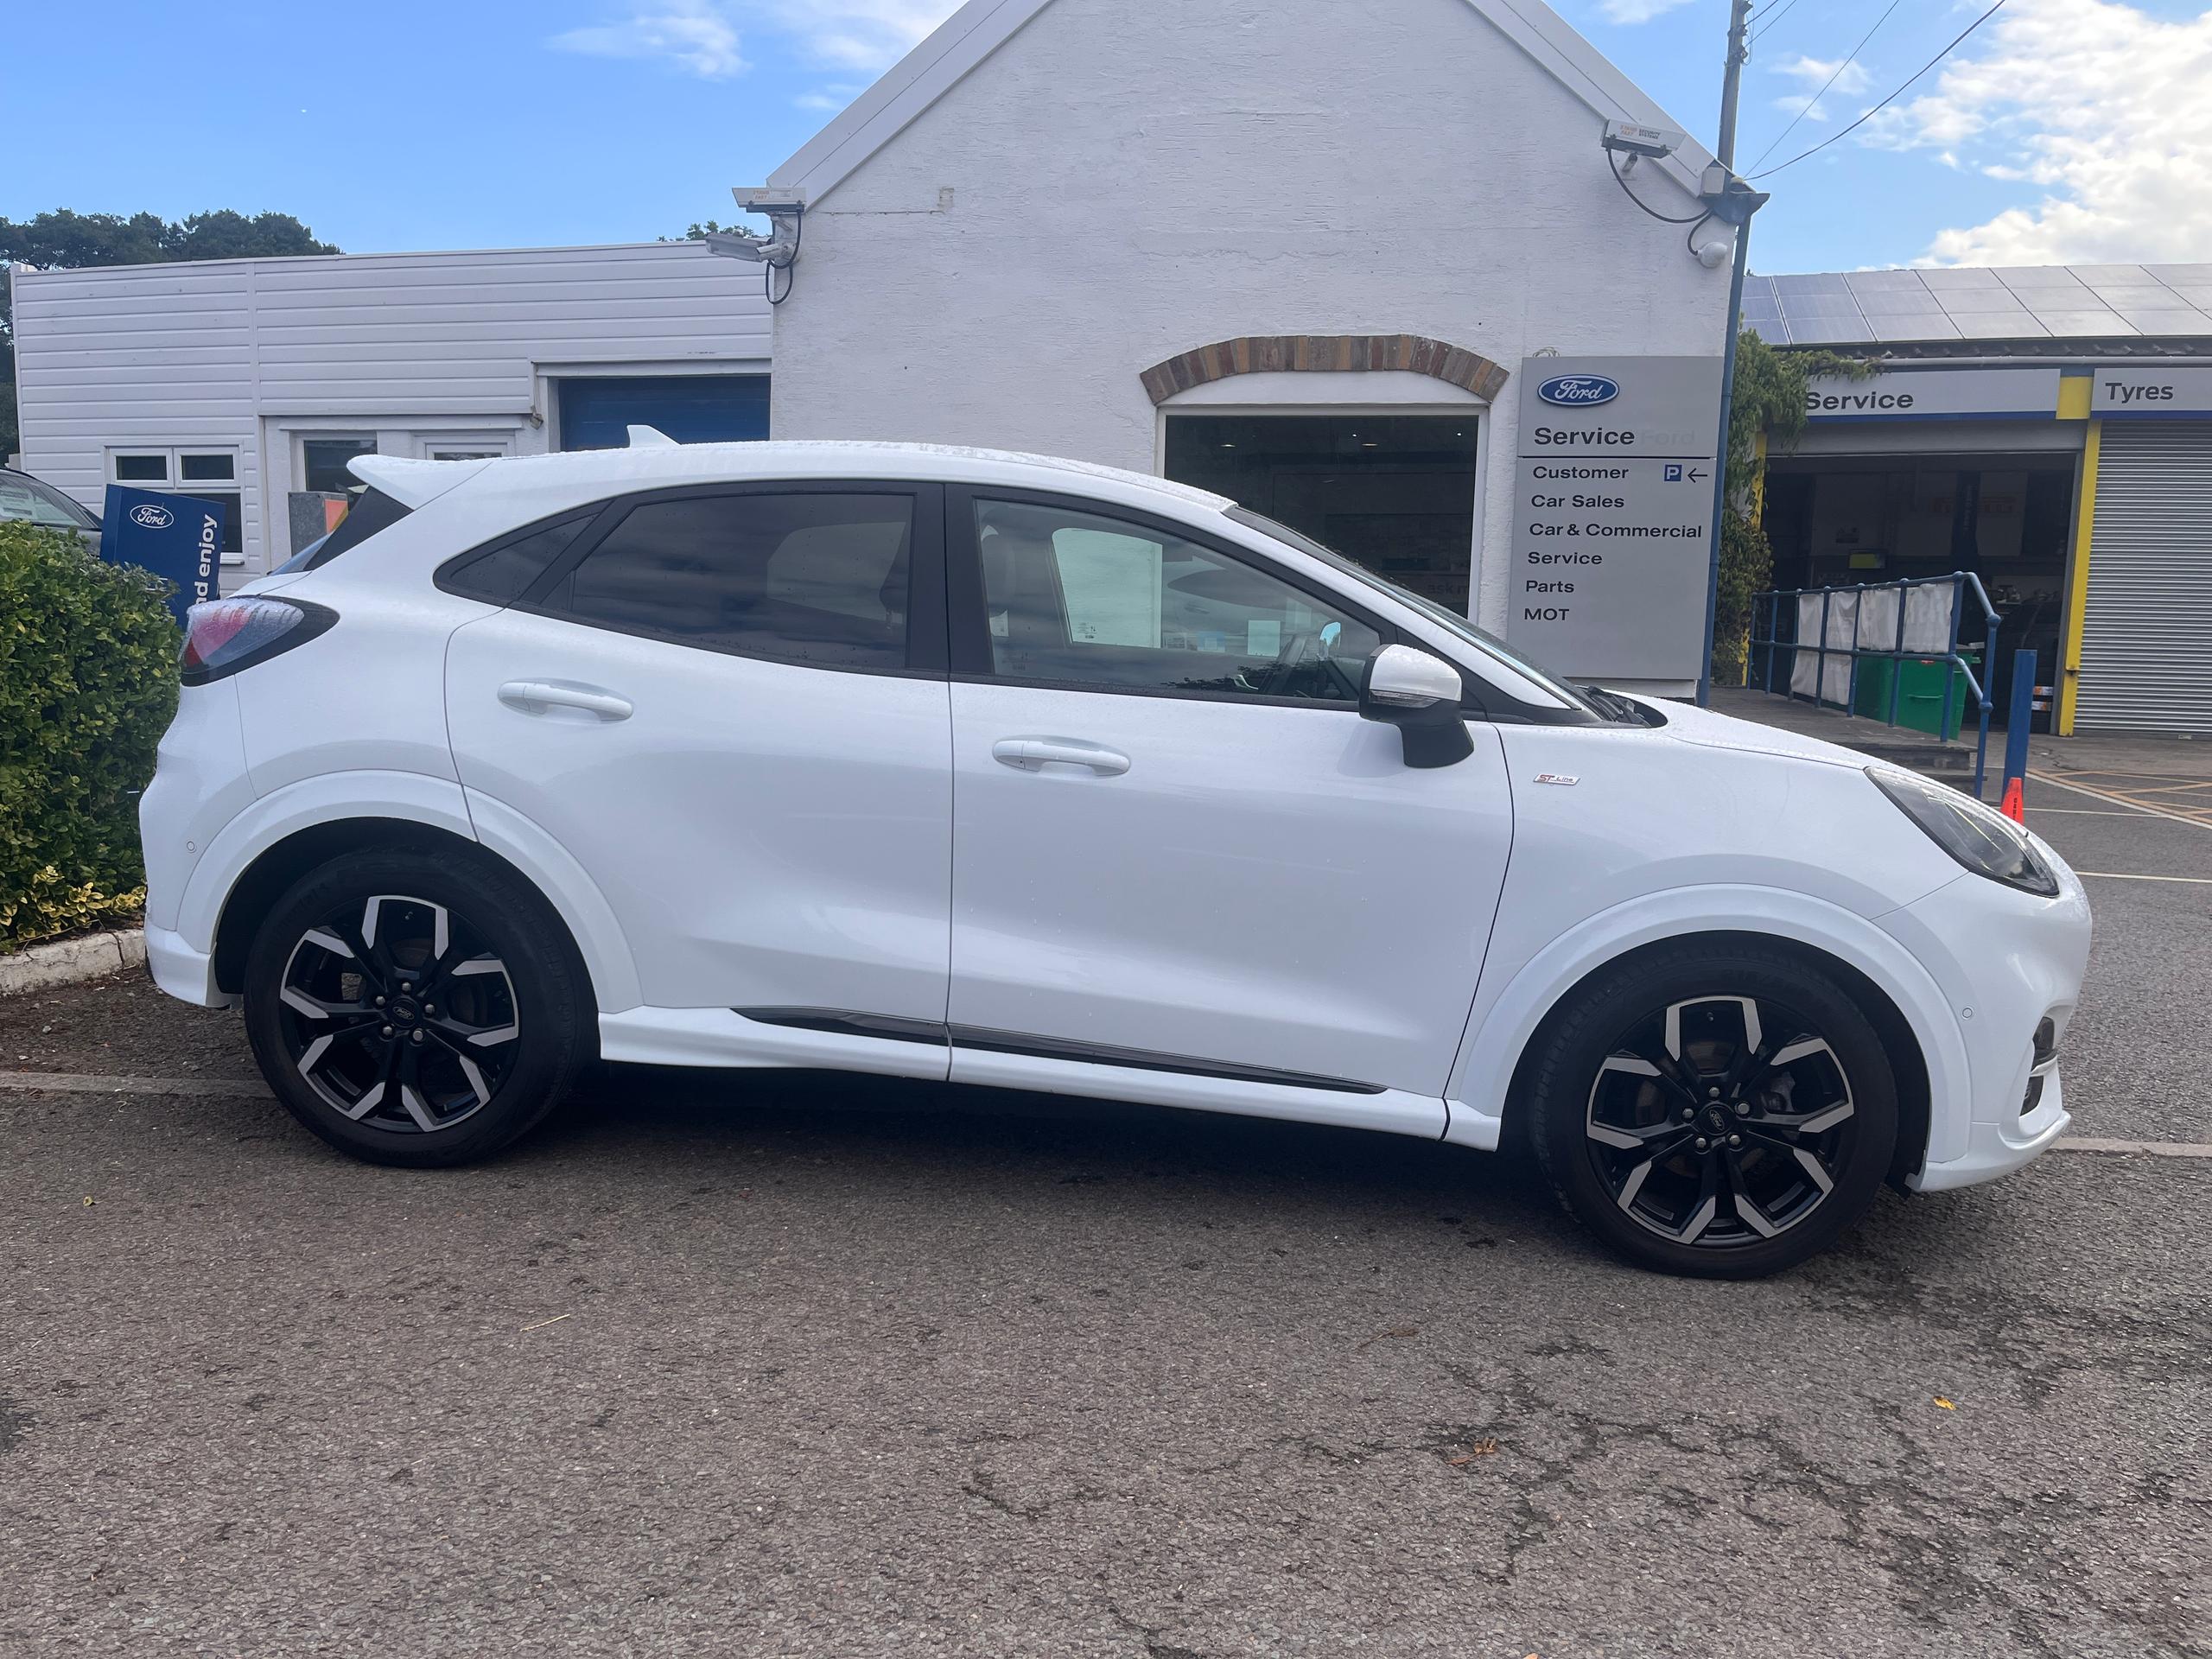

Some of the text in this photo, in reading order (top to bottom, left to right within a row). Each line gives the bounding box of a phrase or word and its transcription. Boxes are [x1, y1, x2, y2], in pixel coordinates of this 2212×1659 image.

[1554, 379, 1604, 400] Ford
[2105, 383, 2173, 404] Tyres
[1807, 391, 1914, 410] Service
[1534, 427, 1635, 445] Service
[1533, 466, 1629, 479] Customer
[1531, 494, 1624, 508] Car Sales
[137, 507, 167, 525] Ford
[1529, 523, 1702, 537] Car & Commercial
[199, 513, 218, 577] enjoy
[1528, 551, 1603, 564] Service
[1526, 580, 1574, 593] Parts
[1524, 607, 1569, 620] MOT
